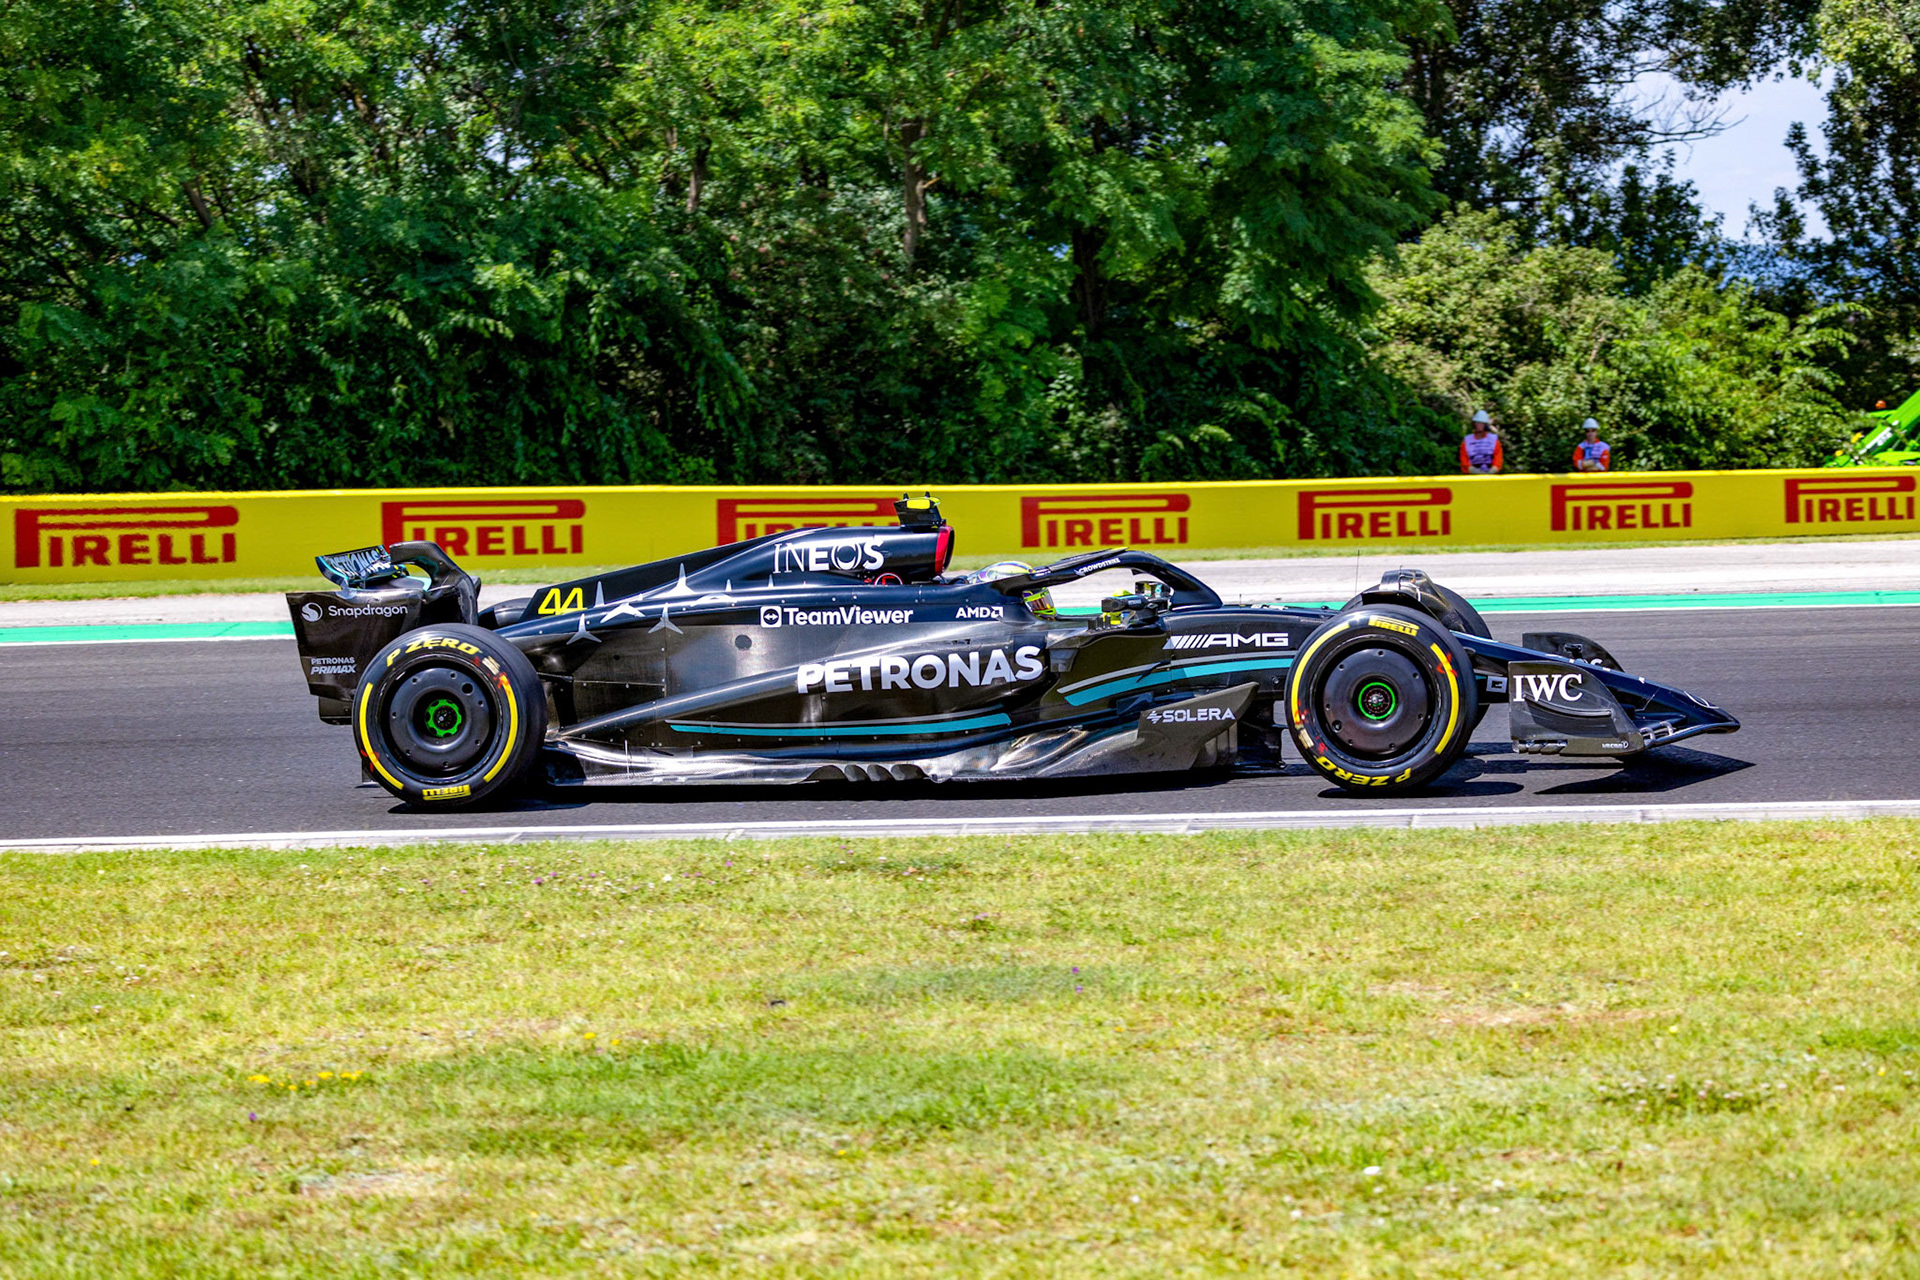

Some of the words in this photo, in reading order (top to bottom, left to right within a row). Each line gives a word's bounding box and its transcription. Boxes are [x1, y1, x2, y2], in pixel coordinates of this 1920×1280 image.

[1298, 487, 1452, 539] PIRELLI
[1551, 482, 1693, 531] PIRELLI
[1784, 476, 1916, 523] PIRELLI
[1020, 493, 1190, 547] PIRELLI
[15, 506, 239, 568] PIRELLI
[773, 539, 884, 573] INEOS
[1079, 557, 1121, 574] CROWDSTRIKE
[329, 604, 408, 618] Snapdragon
[538, 587, 588, 615] 44
[955, 606, 991, 618] AMD
[783, 606, 914, 626] TeamViewer
[1368, 615, 1420, 637] PIRELLI
[386, 648, 401, 667] P
[405, 636, 482, 656] ZERO
[1202, 632, 1289, 648] AMG
[310, 664, 357, 675] PRIMAX
[311, 657, 355, 665] PETRONAS
[797, 645, 1044, 694] PETRONAS
[1512, 673, 1584, 702] IWC
[1162, 707, 1236, 723] SOLERA
[1316, 756, 1391, 787] ZERO
[1395, 767, 1412, 784] P
